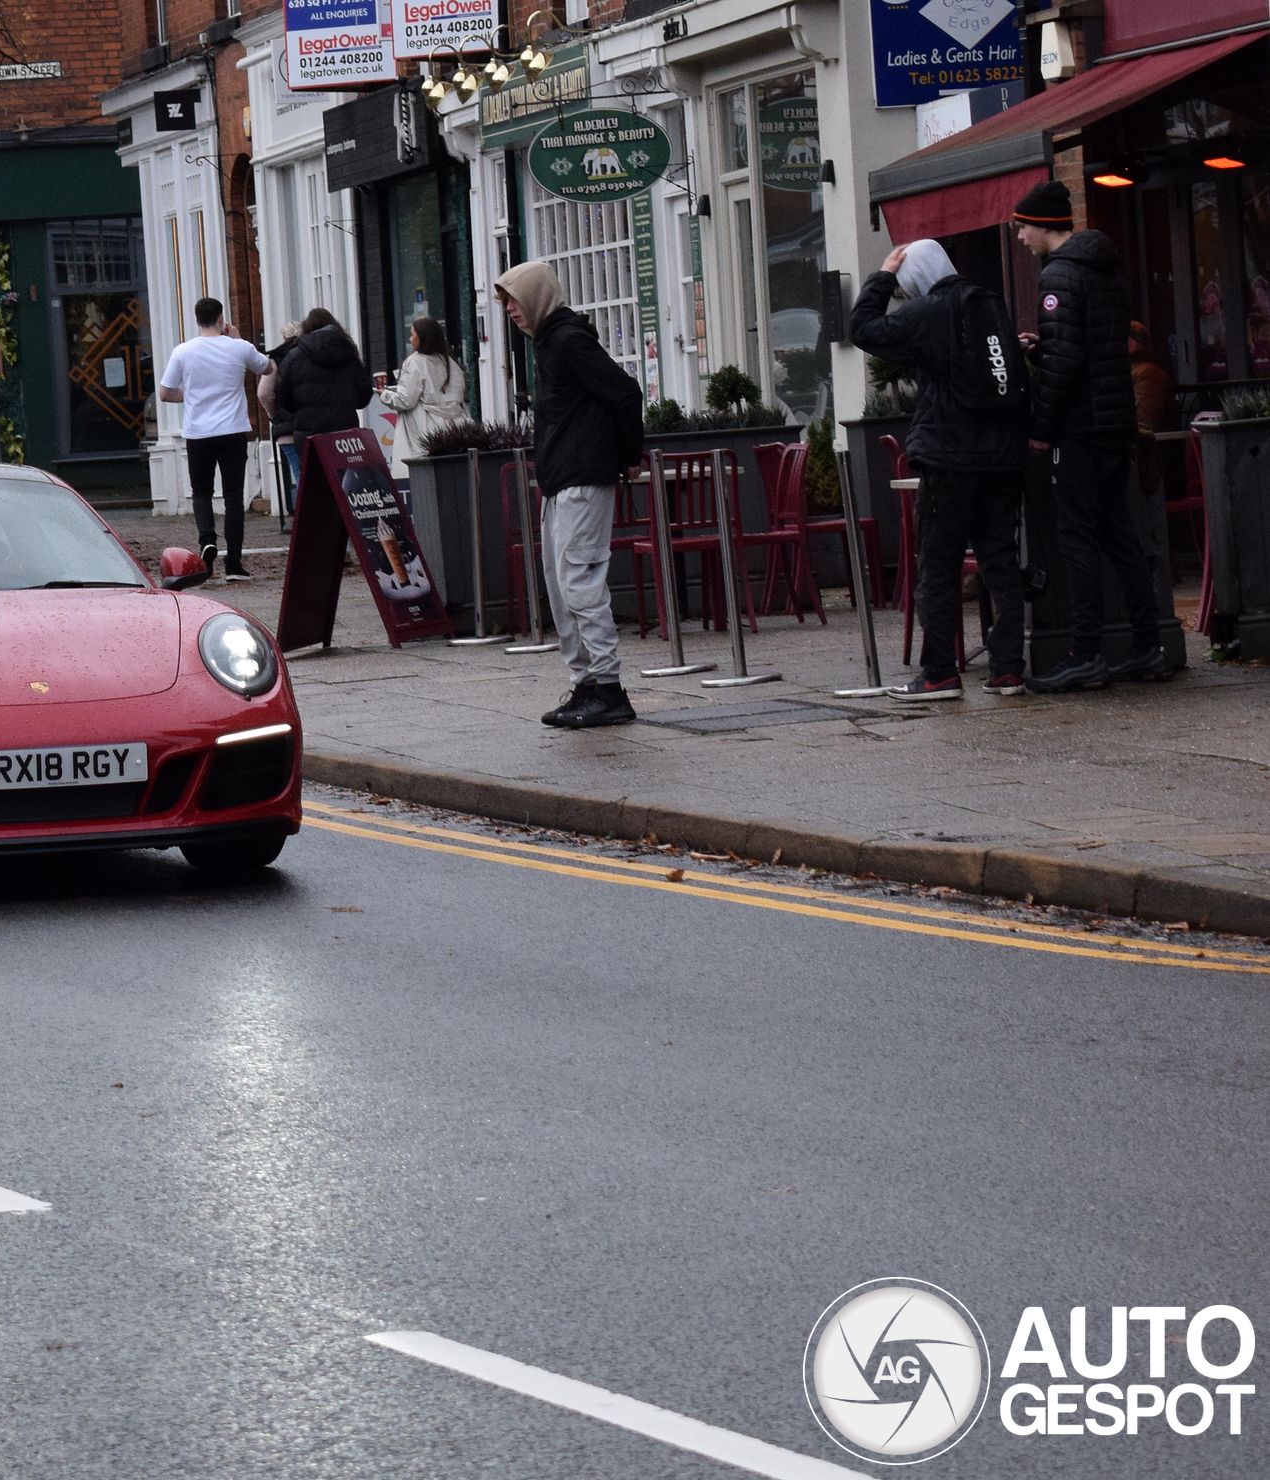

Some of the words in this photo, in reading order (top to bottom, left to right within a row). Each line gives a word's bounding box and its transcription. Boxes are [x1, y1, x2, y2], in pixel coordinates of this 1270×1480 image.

[311, 12, 324, 21] ALL
[325, 8, 368, 20] ENQUIRIES
[405, 23, 443, 37] 01244
[447, 18, 493, 32] 408200
[948, 16, 990, 31] Edge
[300, 56, 336, 68] 01244
[340, 52, 383, 64] 408200
[887, 50, 927, 67] Ladies
[930, 48, 942, 64] &
[946, 47, 983, 63] Gents
[988, 45, 1017, 60] Hair
[21, 64, 57, 77] STREET
[300, 63, 384, 80] legatowen.co.uk
[908, 71, 935, 85] Tel:
[938, 69, 981, 83] 01625
[573, 117, 619, 132] ALDERLEY
[540, 137, 564, 149] THAI
[565, 132, 606, 147] MASSAGE
[608, 131, 617, 142] &
[618, 127, 655, 142] BEAUTY
[577, 182, 607, 194] 07958
[607, 182, 625, 191] 030
[986, 334, 1008, 396] adidas
[335, 437, 366, 454] COSTA
[347, 488, 384, 508] Oozing
[72, 748, 129, 780] RGY
